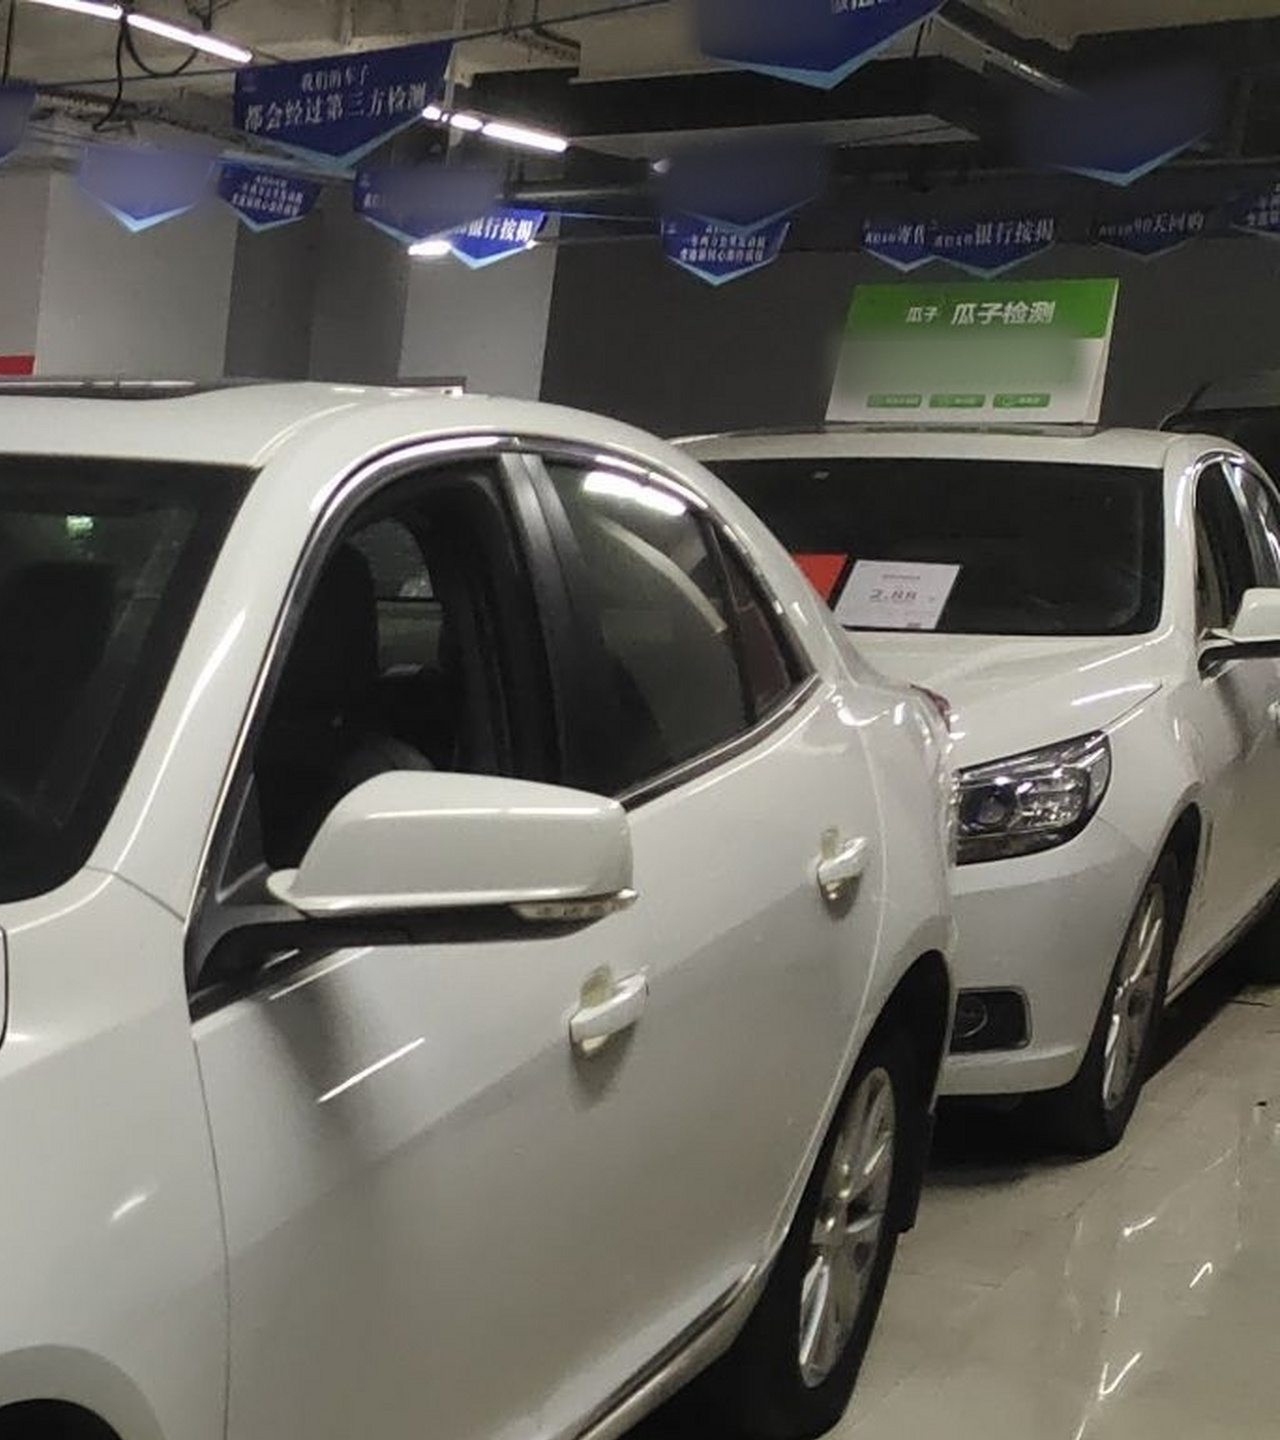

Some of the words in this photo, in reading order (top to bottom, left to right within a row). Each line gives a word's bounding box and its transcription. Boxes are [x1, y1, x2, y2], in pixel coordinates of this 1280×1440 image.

[245, 83, 426, 132] 都会经过第三方检测
[906, 306, 938, 323] 瓜子
[950, 300, 1056, 325] 瓜子检测
